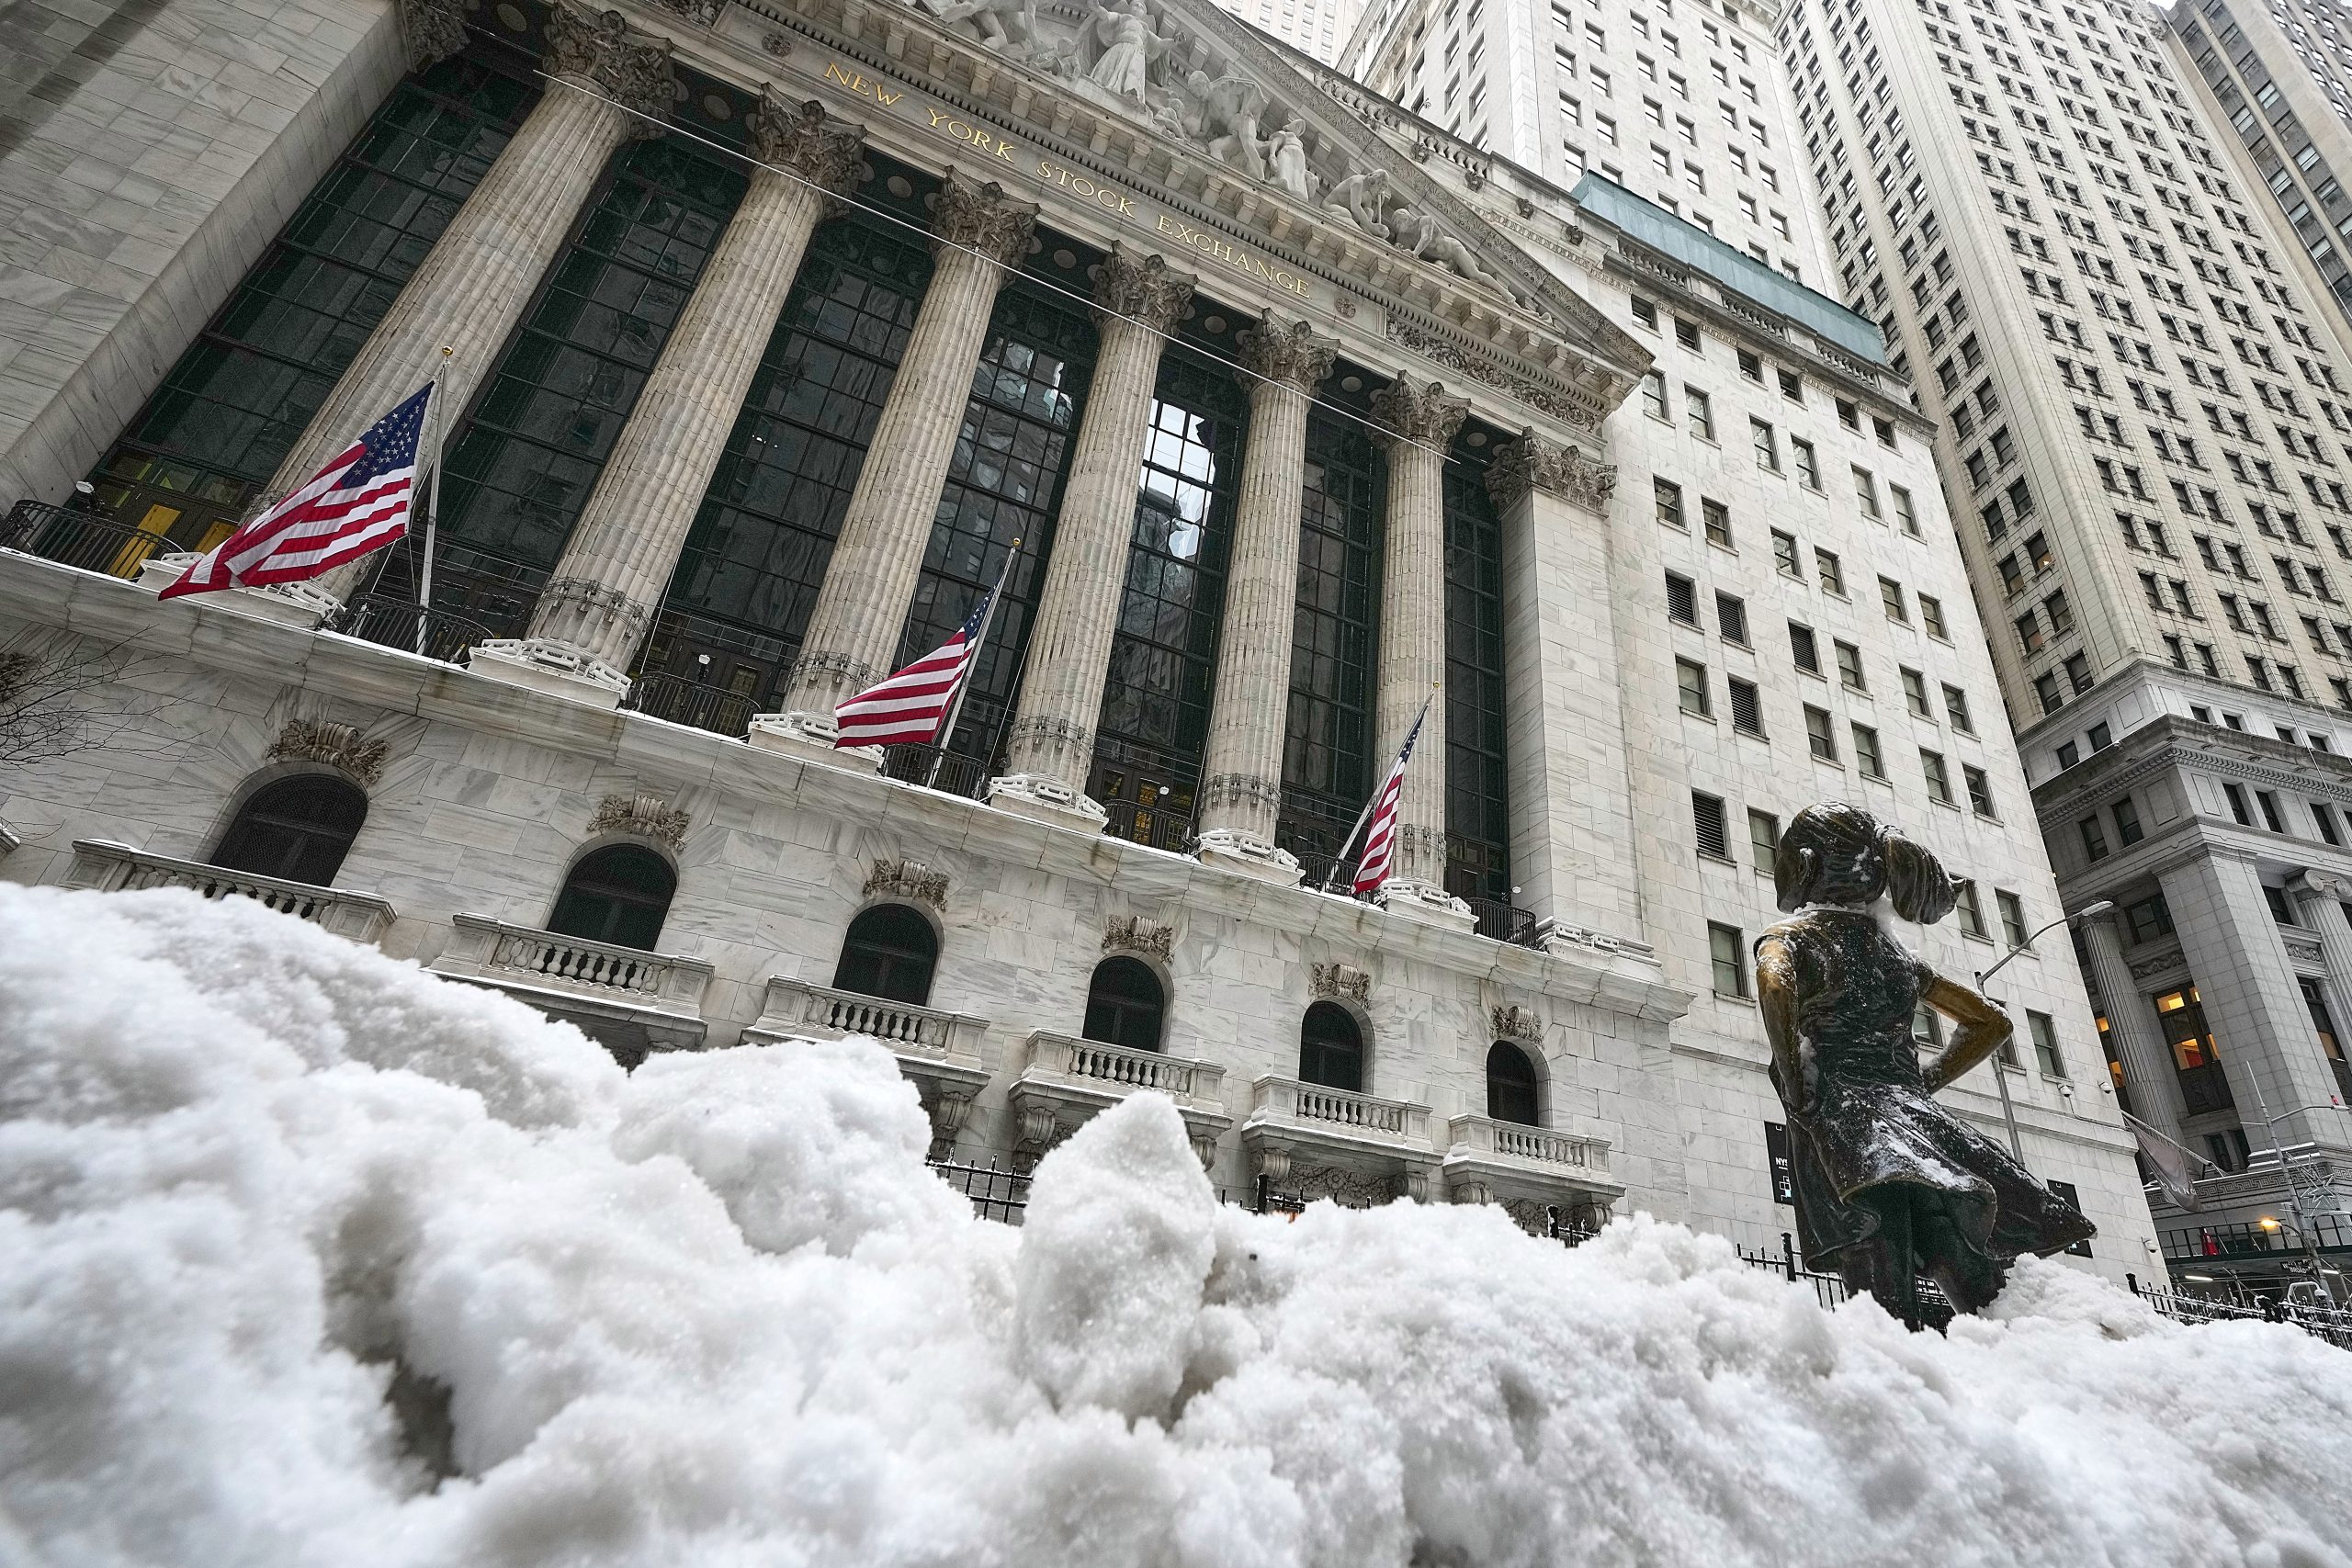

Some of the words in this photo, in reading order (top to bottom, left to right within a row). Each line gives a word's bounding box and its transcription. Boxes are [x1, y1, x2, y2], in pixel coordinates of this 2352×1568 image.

[823, 62, 903, 107] NEW
[926, 107, 1016, 164] YORK
[1036, 162, 1136, 220] STOCK
[1156, 215, 1310, 299] EXCHANGE
[1775, 1156, 1788, 1167] NYS
